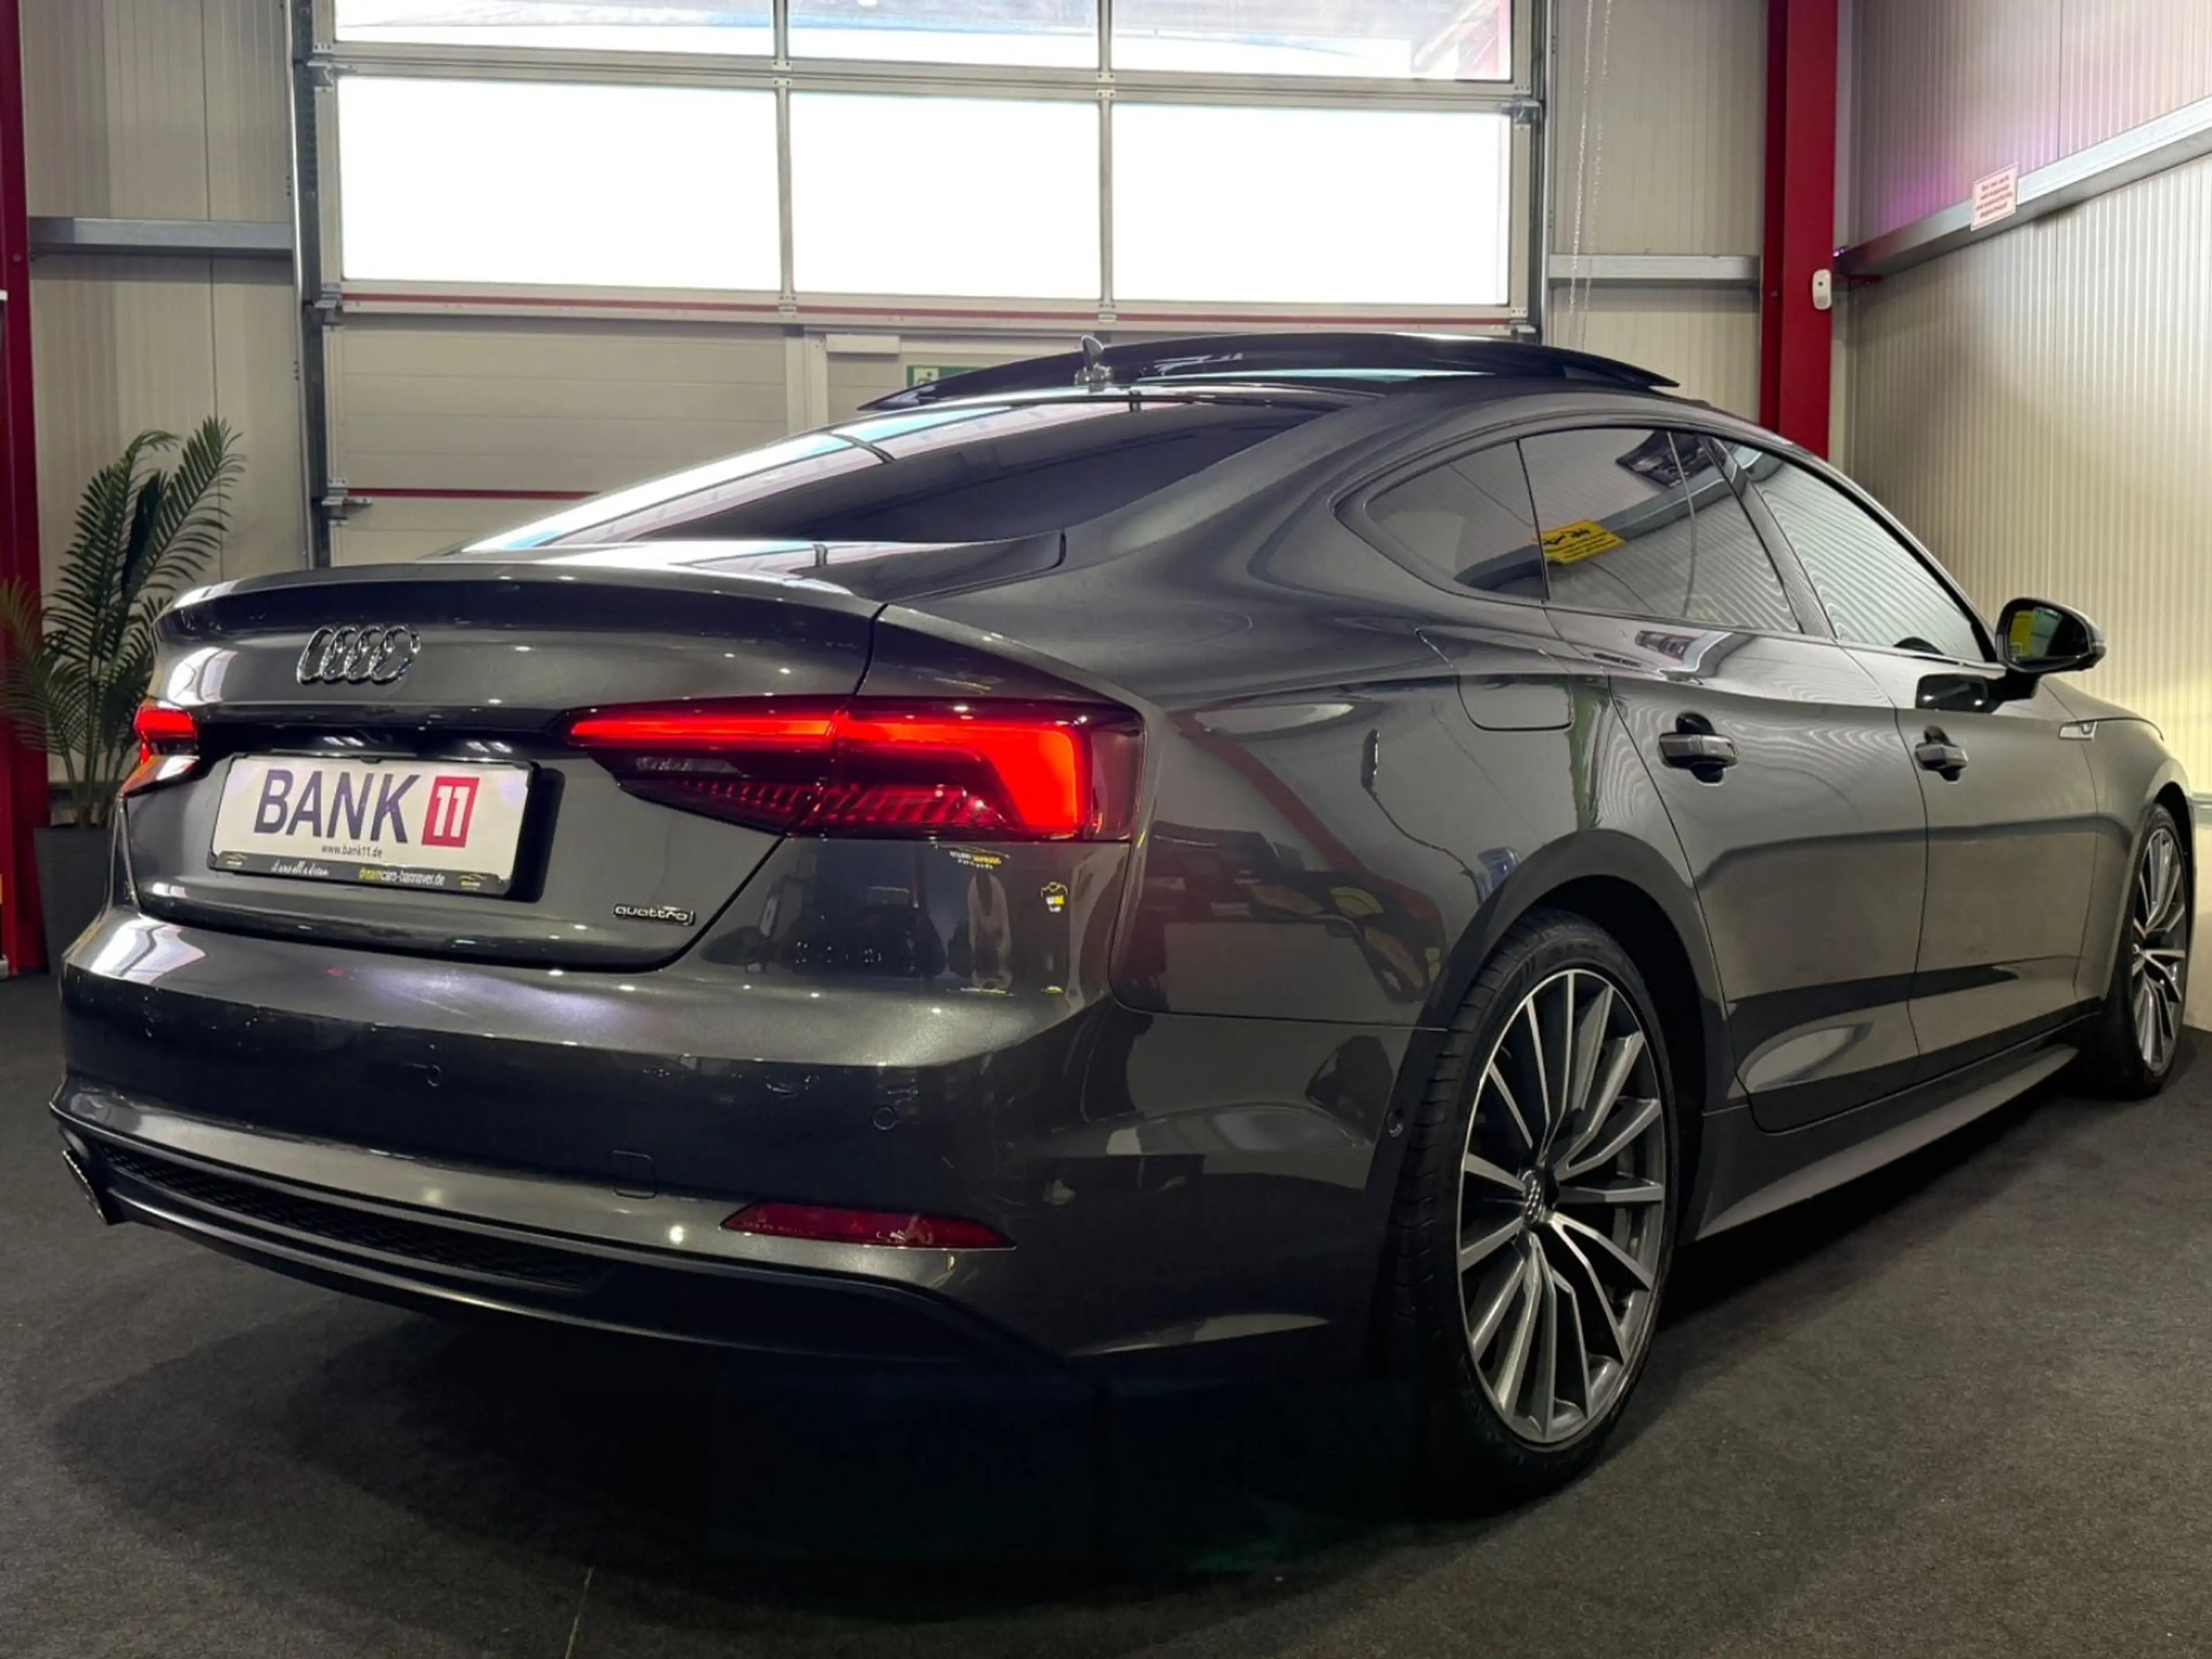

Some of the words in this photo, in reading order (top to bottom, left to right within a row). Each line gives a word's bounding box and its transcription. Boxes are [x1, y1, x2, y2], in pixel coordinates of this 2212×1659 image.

[254, 770, 421, 843] BANK
[434, 785, 471, 838] 11
[322, 843, 382, 858] www.bank11.de
[615, 906, 688, 921] quattro
